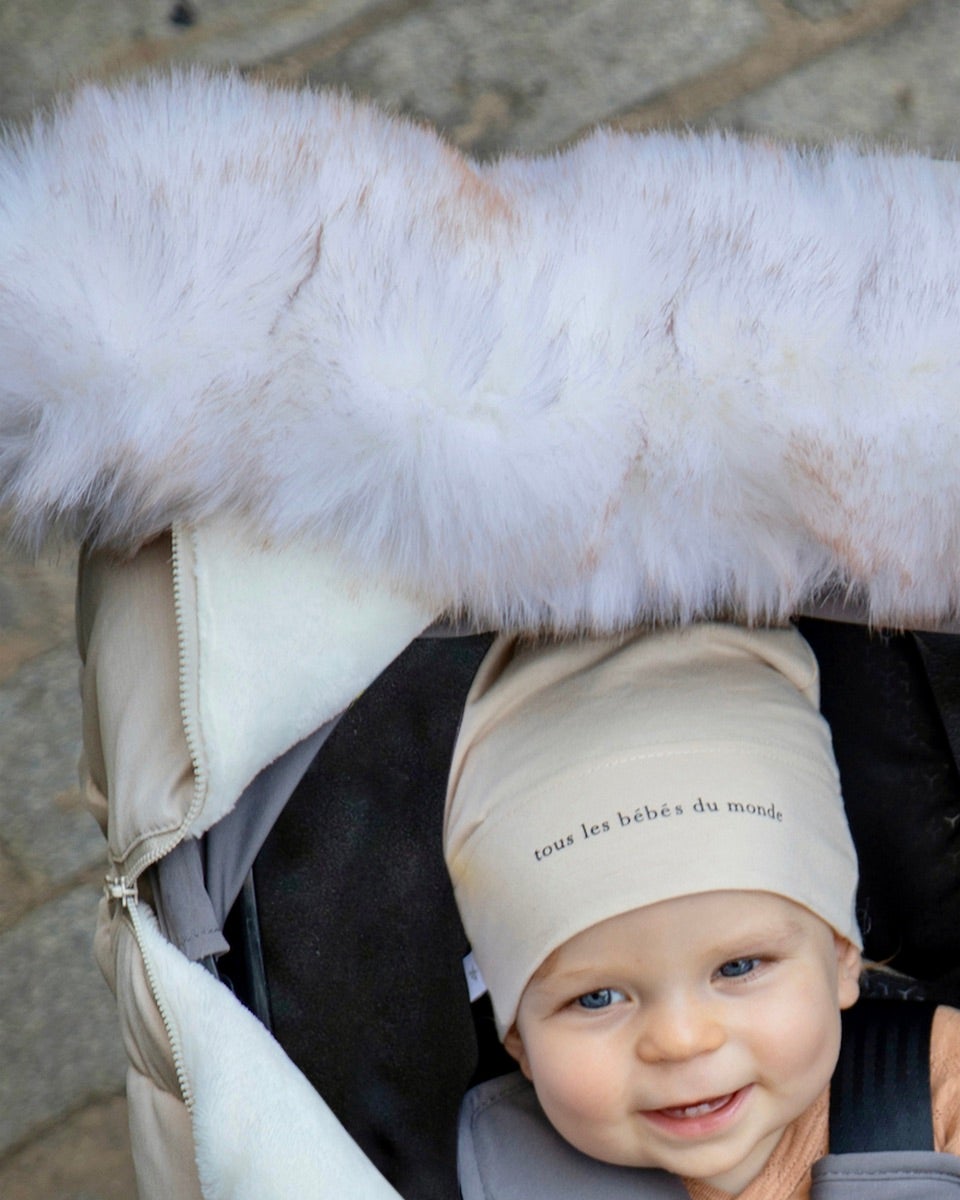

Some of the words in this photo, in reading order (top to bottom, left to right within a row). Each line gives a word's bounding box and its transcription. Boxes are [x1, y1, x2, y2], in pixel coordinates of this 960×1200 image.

[534, 834, 575, 861] tous
[581, 818, 611, 840] les
[617, 804, 684, 828] bébés
[692, 797, 719, 814] du
[727, 800, 784, 822] monde
